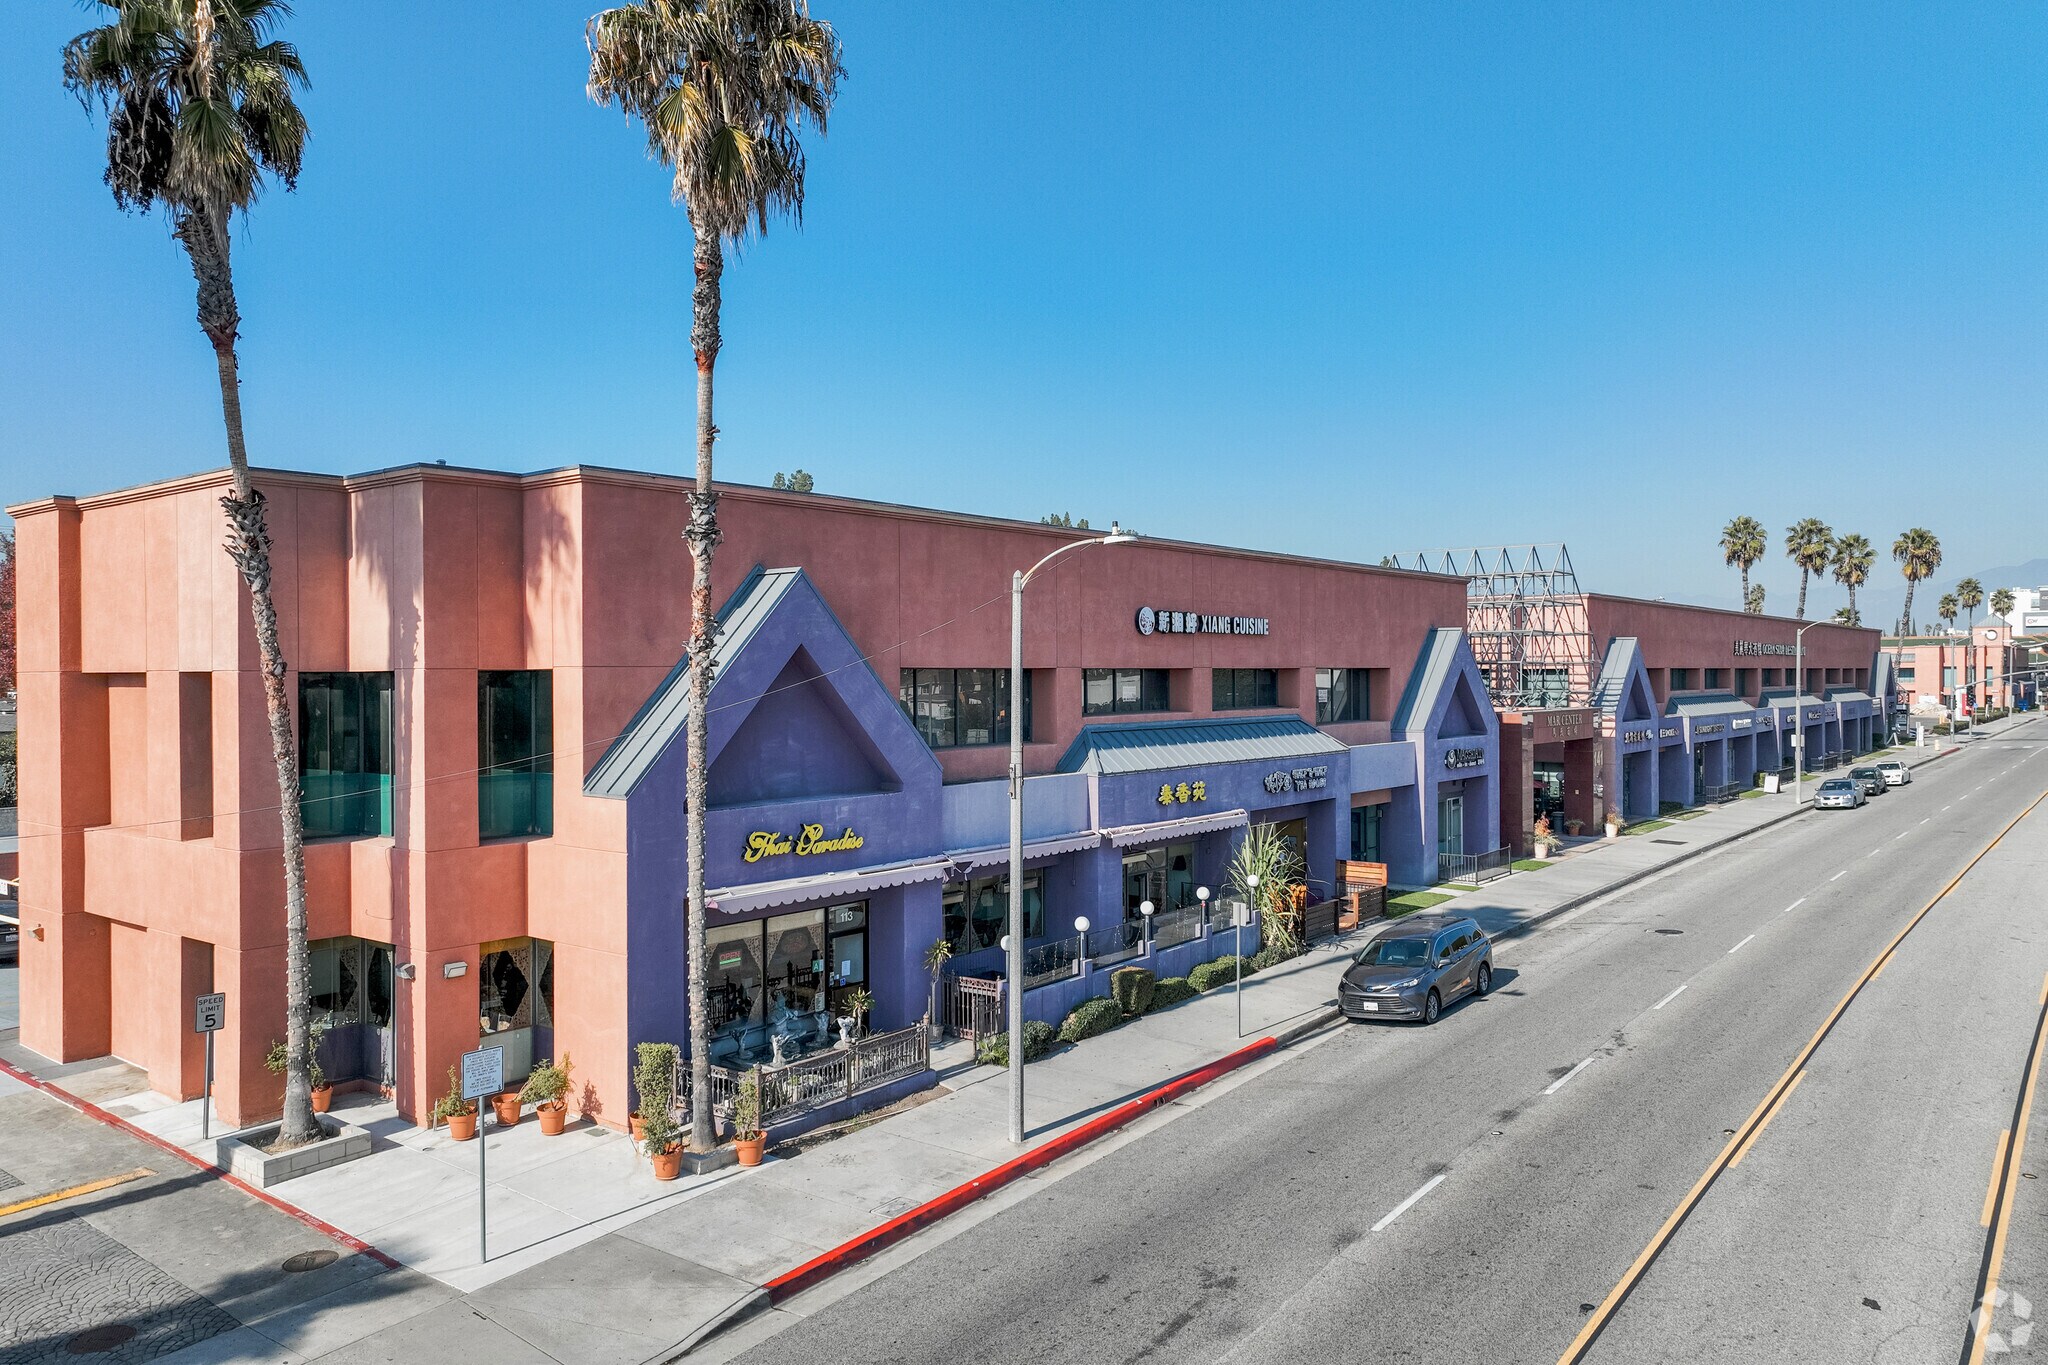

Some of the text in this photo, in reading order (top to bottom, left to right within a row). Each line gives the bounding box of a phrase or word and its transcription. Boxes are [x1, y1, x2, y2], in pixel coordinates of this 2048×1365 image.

[1201, 615, 1269, 635] XIANG CUISINE
[1561, 713, 1583, 726] CENTER
[743, 823, 864, 863] Thai Paradise
[840, 911, 853, 923] 113
[719, 950, 741, 961] OPEN
[198, 996, 224, 1006] SPEED
[200, 1004, 221, 1013] LIMIT
[204, 1013, 217, 1028] 5
